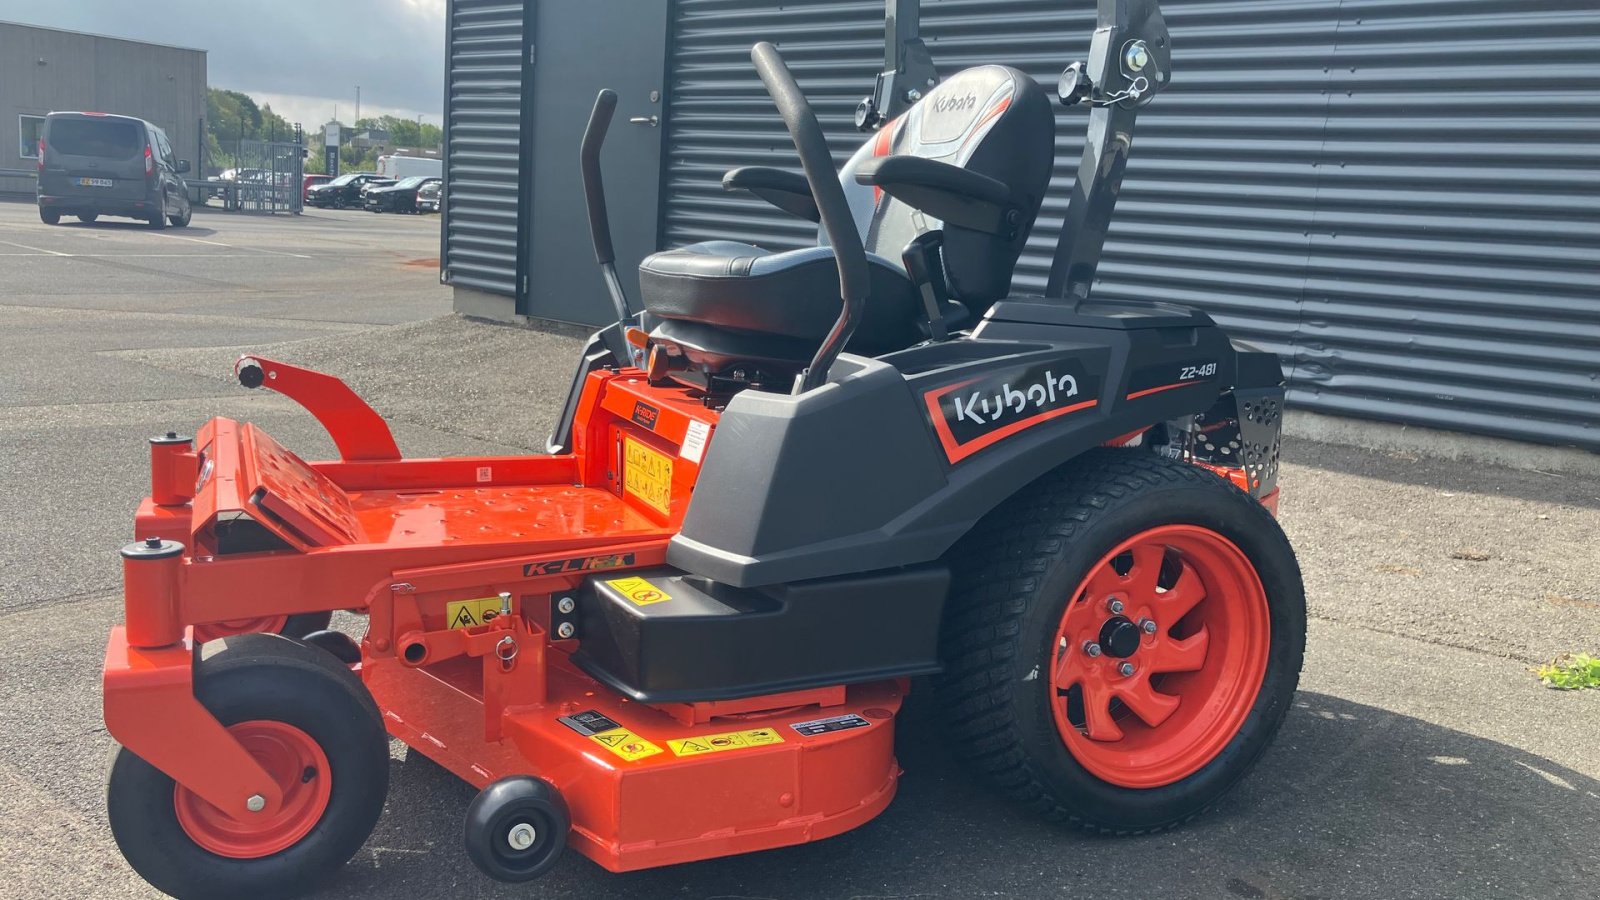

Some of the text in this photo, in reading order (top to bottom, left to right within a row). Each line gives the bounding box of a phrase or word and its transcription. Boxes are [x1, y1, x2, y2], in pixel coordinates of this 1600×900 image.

[933, 92, 977, 113] Kubota
[1180, 362, 1217, 380] Z2-481
[954, 370, 1079, 425] Kubota
[635, 404, 657, 422] K-RIDE
[527, 553, 633, 577] K-LIFT
